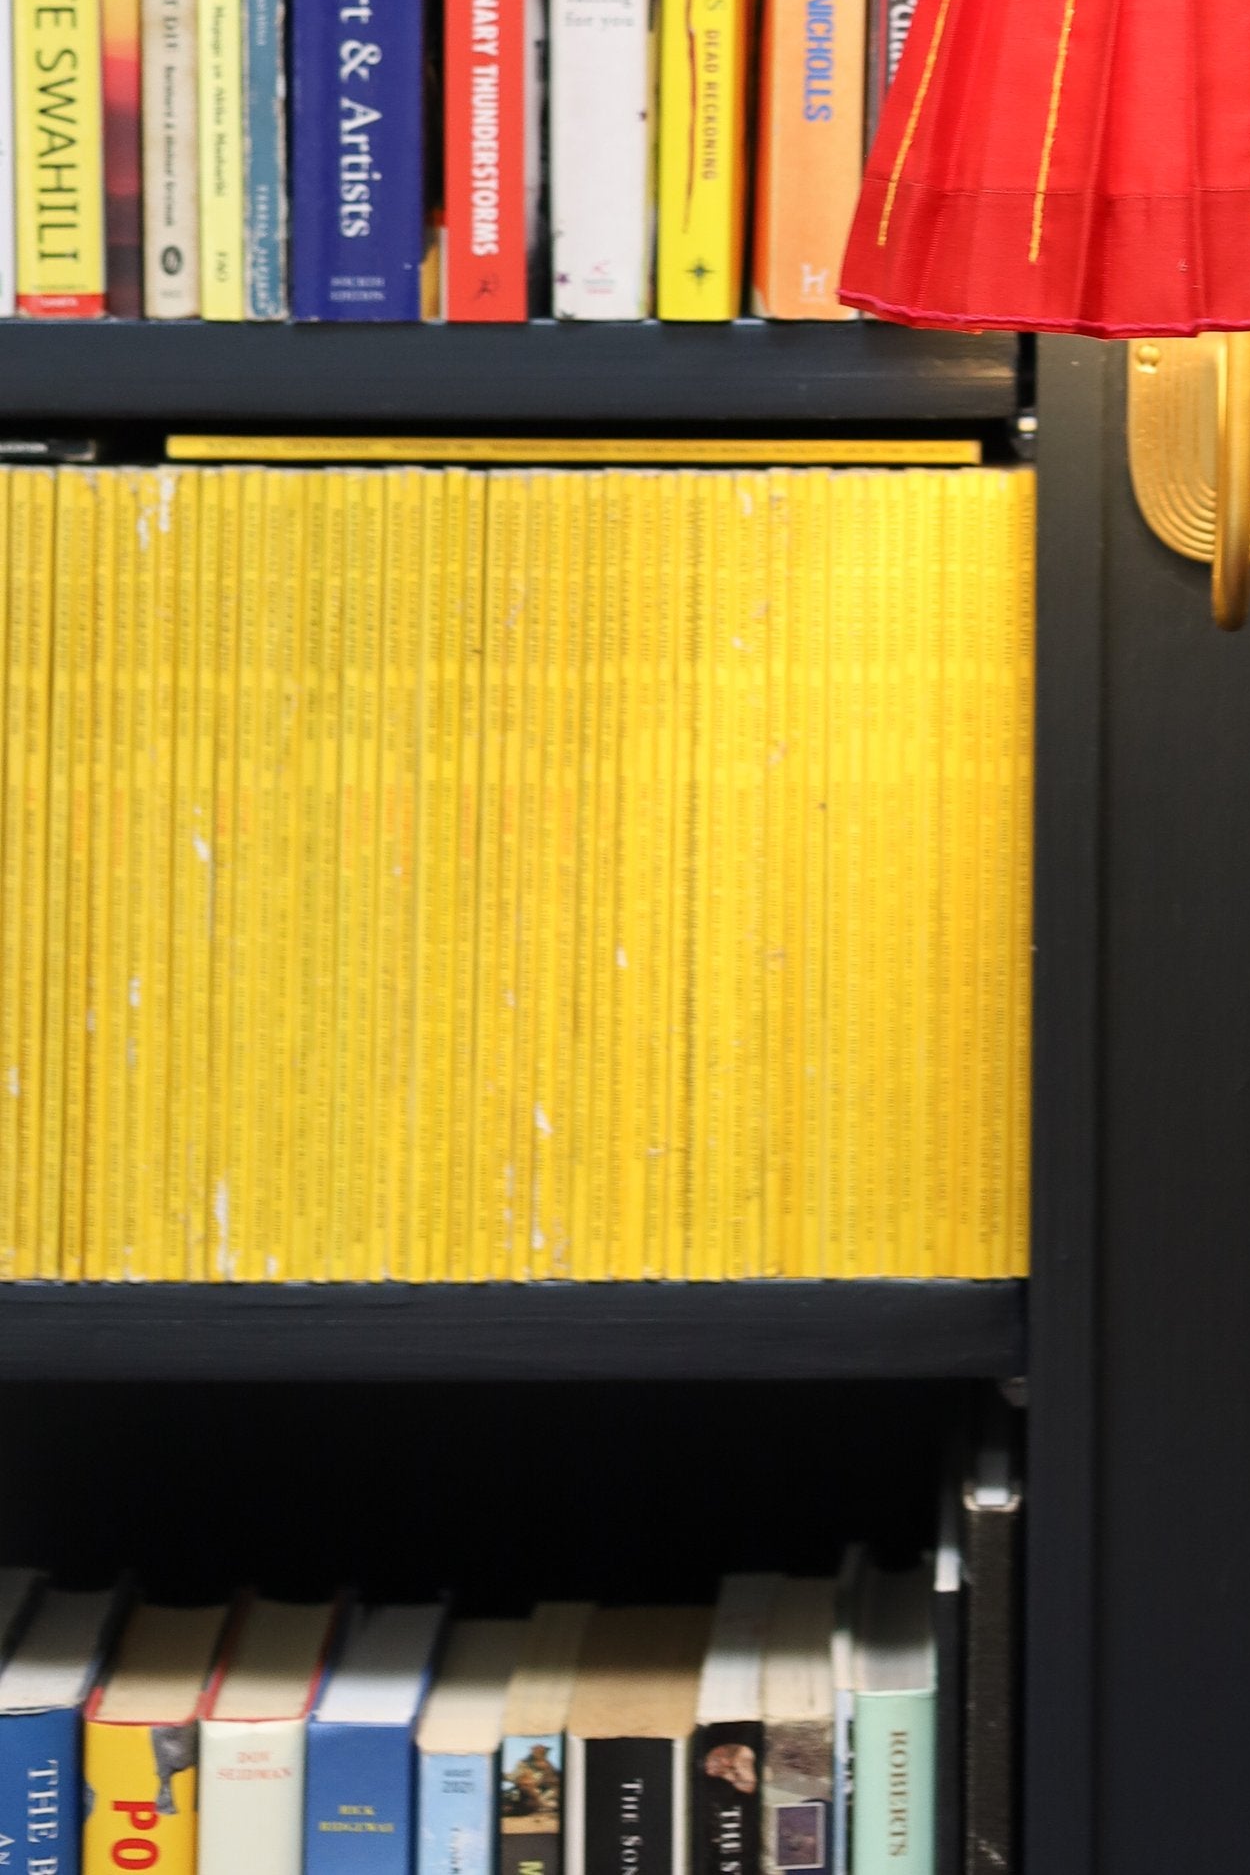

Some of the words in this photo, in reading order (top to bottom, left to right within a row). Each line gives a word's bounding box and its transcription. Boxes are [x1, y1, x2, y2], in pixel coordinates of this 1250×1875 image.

[340, 39, 383, 82] &
[700, 29, 720, 73] DEAD
[34, 47, 79, 264] SWAHILI
[340, 96, 384, 239] Artists
[470, 65, 500, 256] THUNDERSTORMS
[700, 82, 720, 181] RECKONING
[28, 1759, 59, 1844] THE
[888, 1729, 909, 1858] ROBERTS
